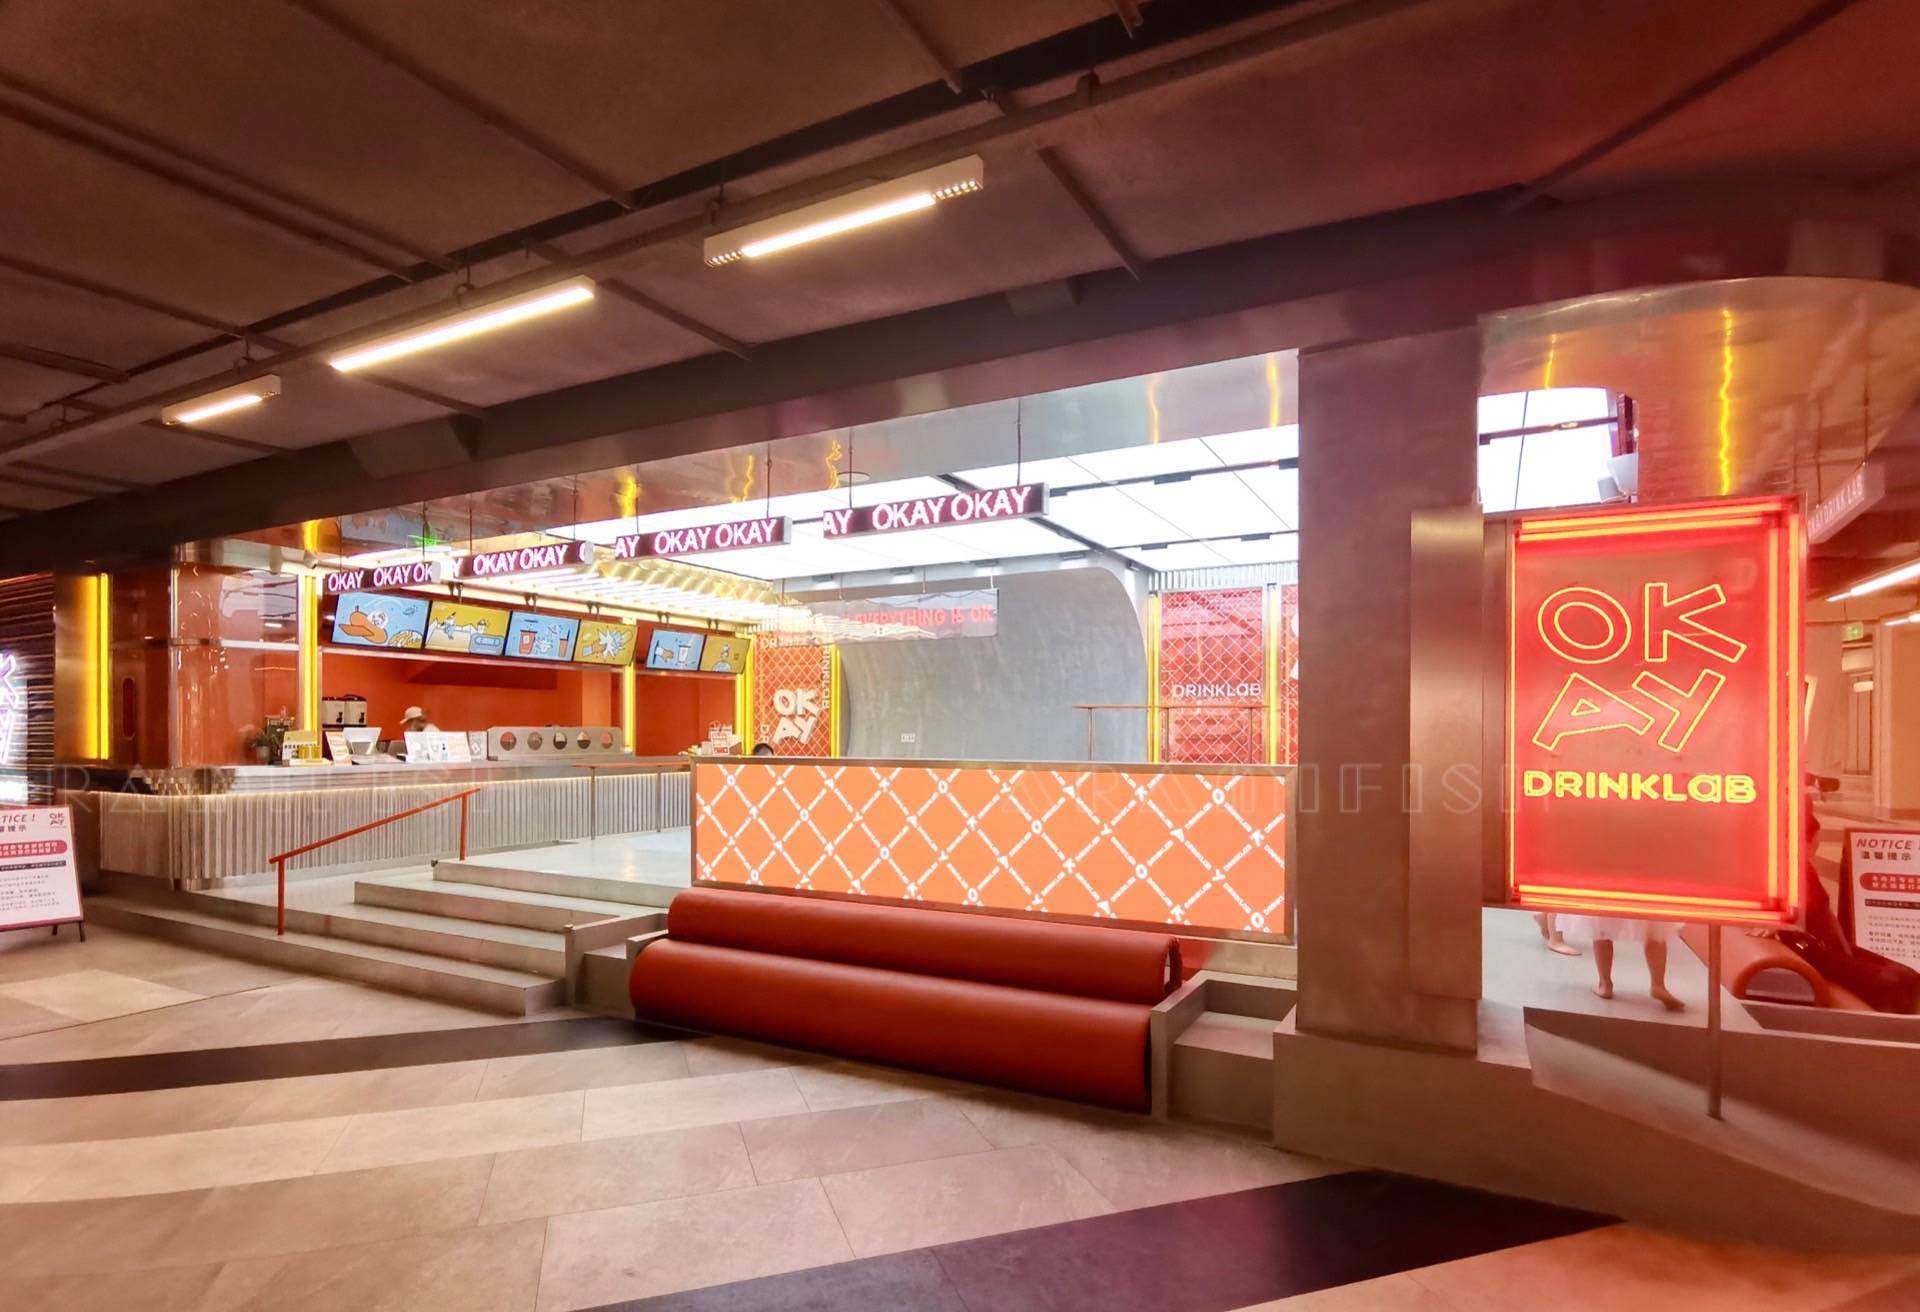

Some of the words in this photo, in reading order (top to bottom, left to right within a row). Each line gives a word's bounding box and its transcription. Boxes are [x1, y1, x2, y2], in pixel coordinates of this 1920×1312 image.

[872, 497, 946, 530] OKAY
[951, 486, 1031, 520] OKAY
[615, 536, 640, 558] AY
[654, 527, 712, 554] OKAY
[715, 519, 777, 547] OKAY
[473, 551, 518, 575] OKAY
[520, 544, 568, 569] OKAY
[328, 569, 365, 591] OKAY
[373, 565, 411, 586] OKAY
[951, 606, 964, 624] IS
[970, 604, 993, 623] OK
[1537, 582, 1747, 665] OK
[773, 688, 820, 717] OK
[1532, 668, 1726, 753] AY
[772, 715, 817, 745] AY
[1857, 839, 1912, 850] NOTICE
